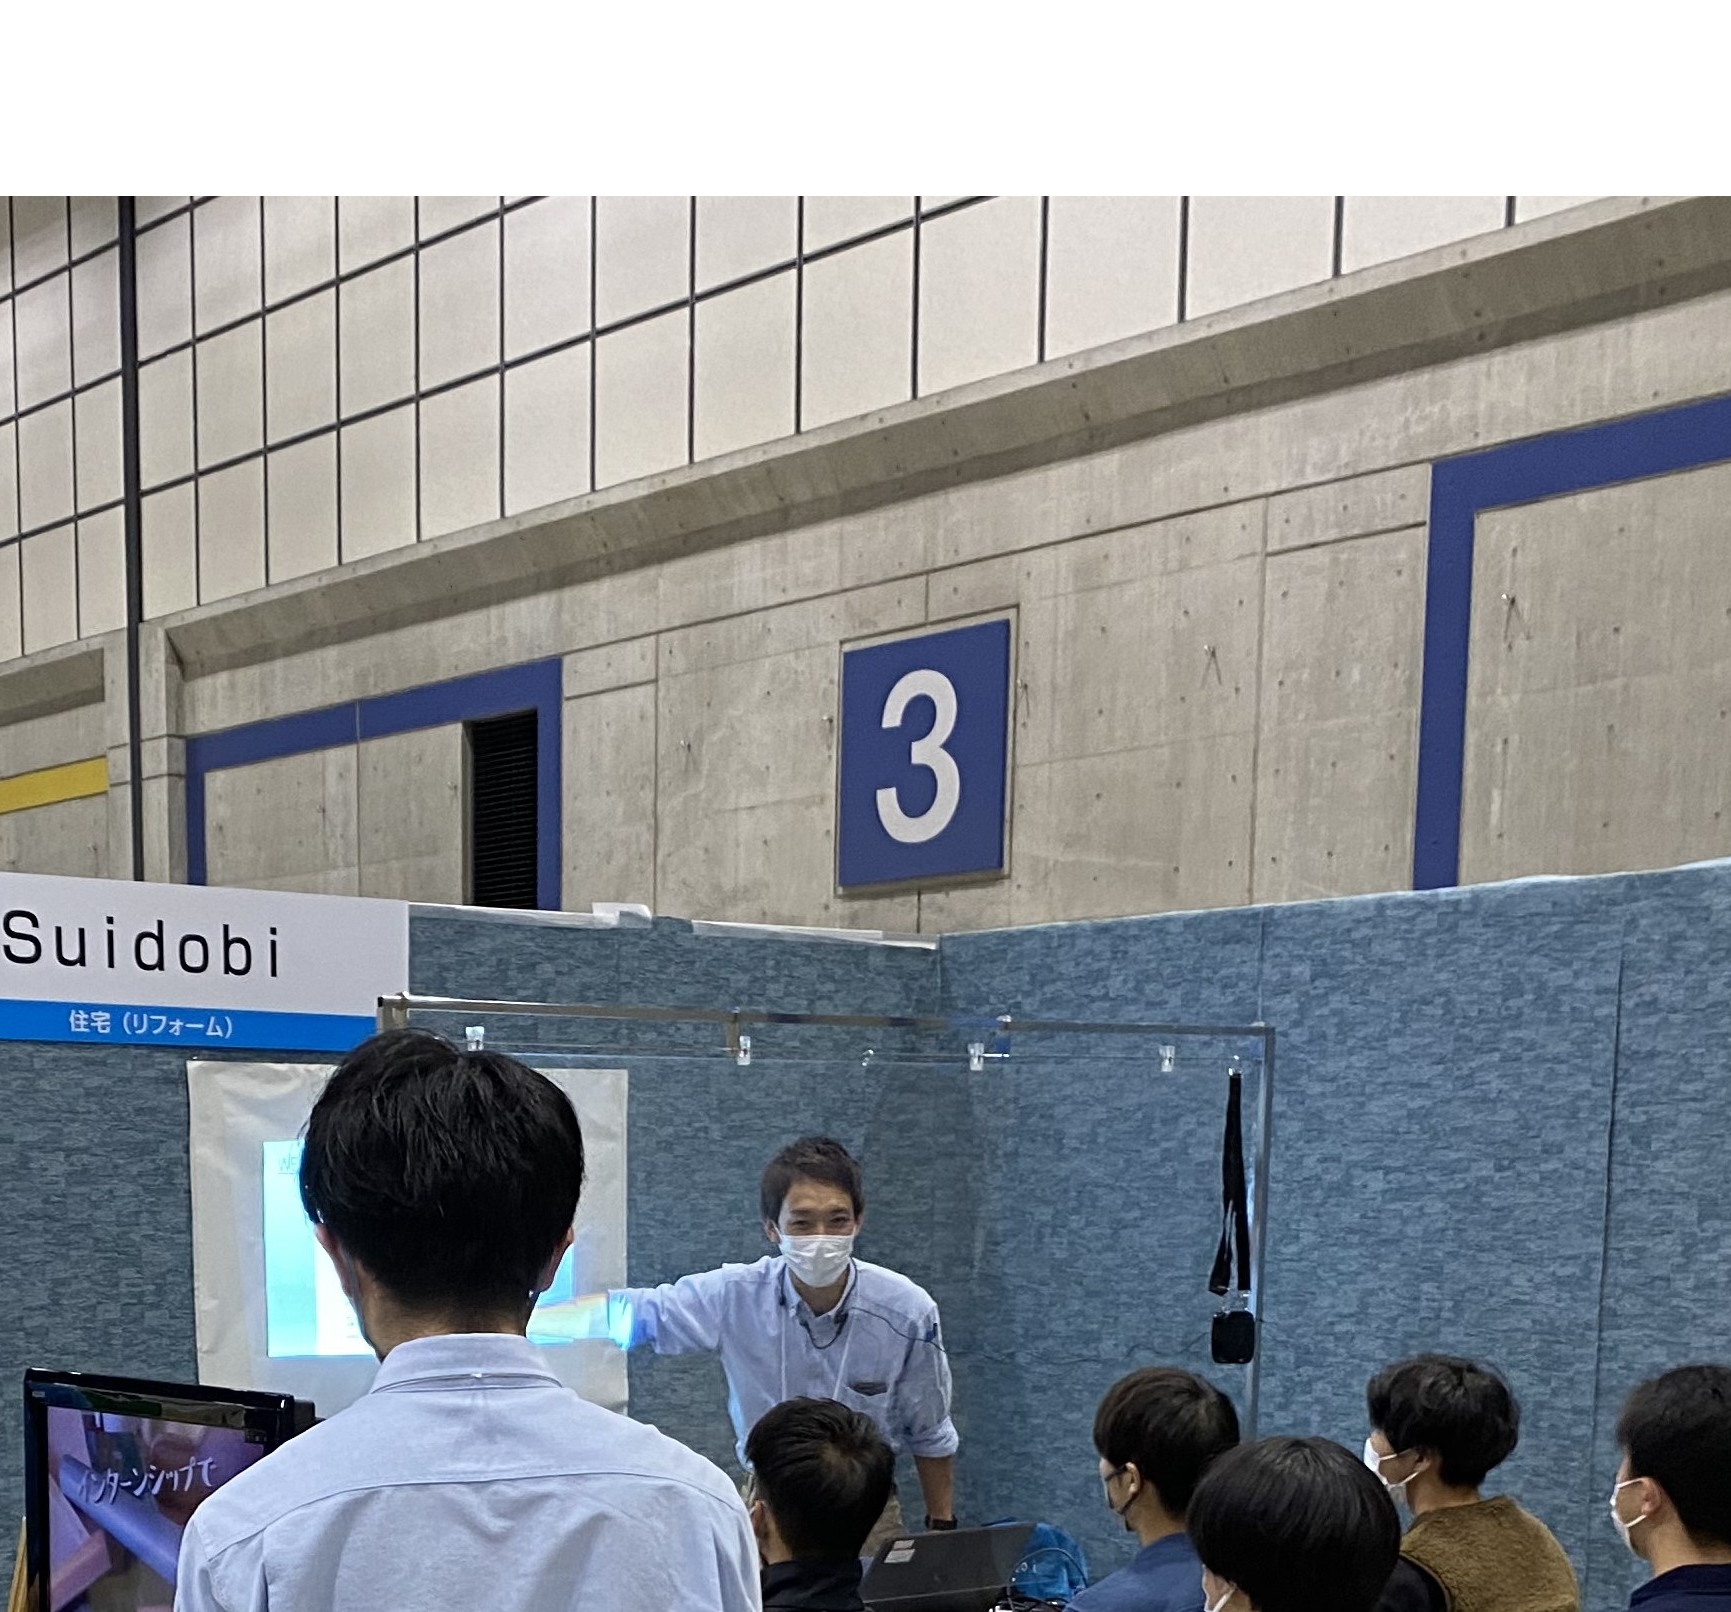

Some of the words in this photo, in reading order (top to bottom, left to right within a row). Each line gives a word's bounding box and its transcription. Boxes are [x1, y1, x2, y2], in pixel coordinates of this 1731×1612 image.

[876, 668, 961, 844] 3
[1, 908, 279, 978] Suidobi
[78, 1455, 218, 1505] インターンシップで
